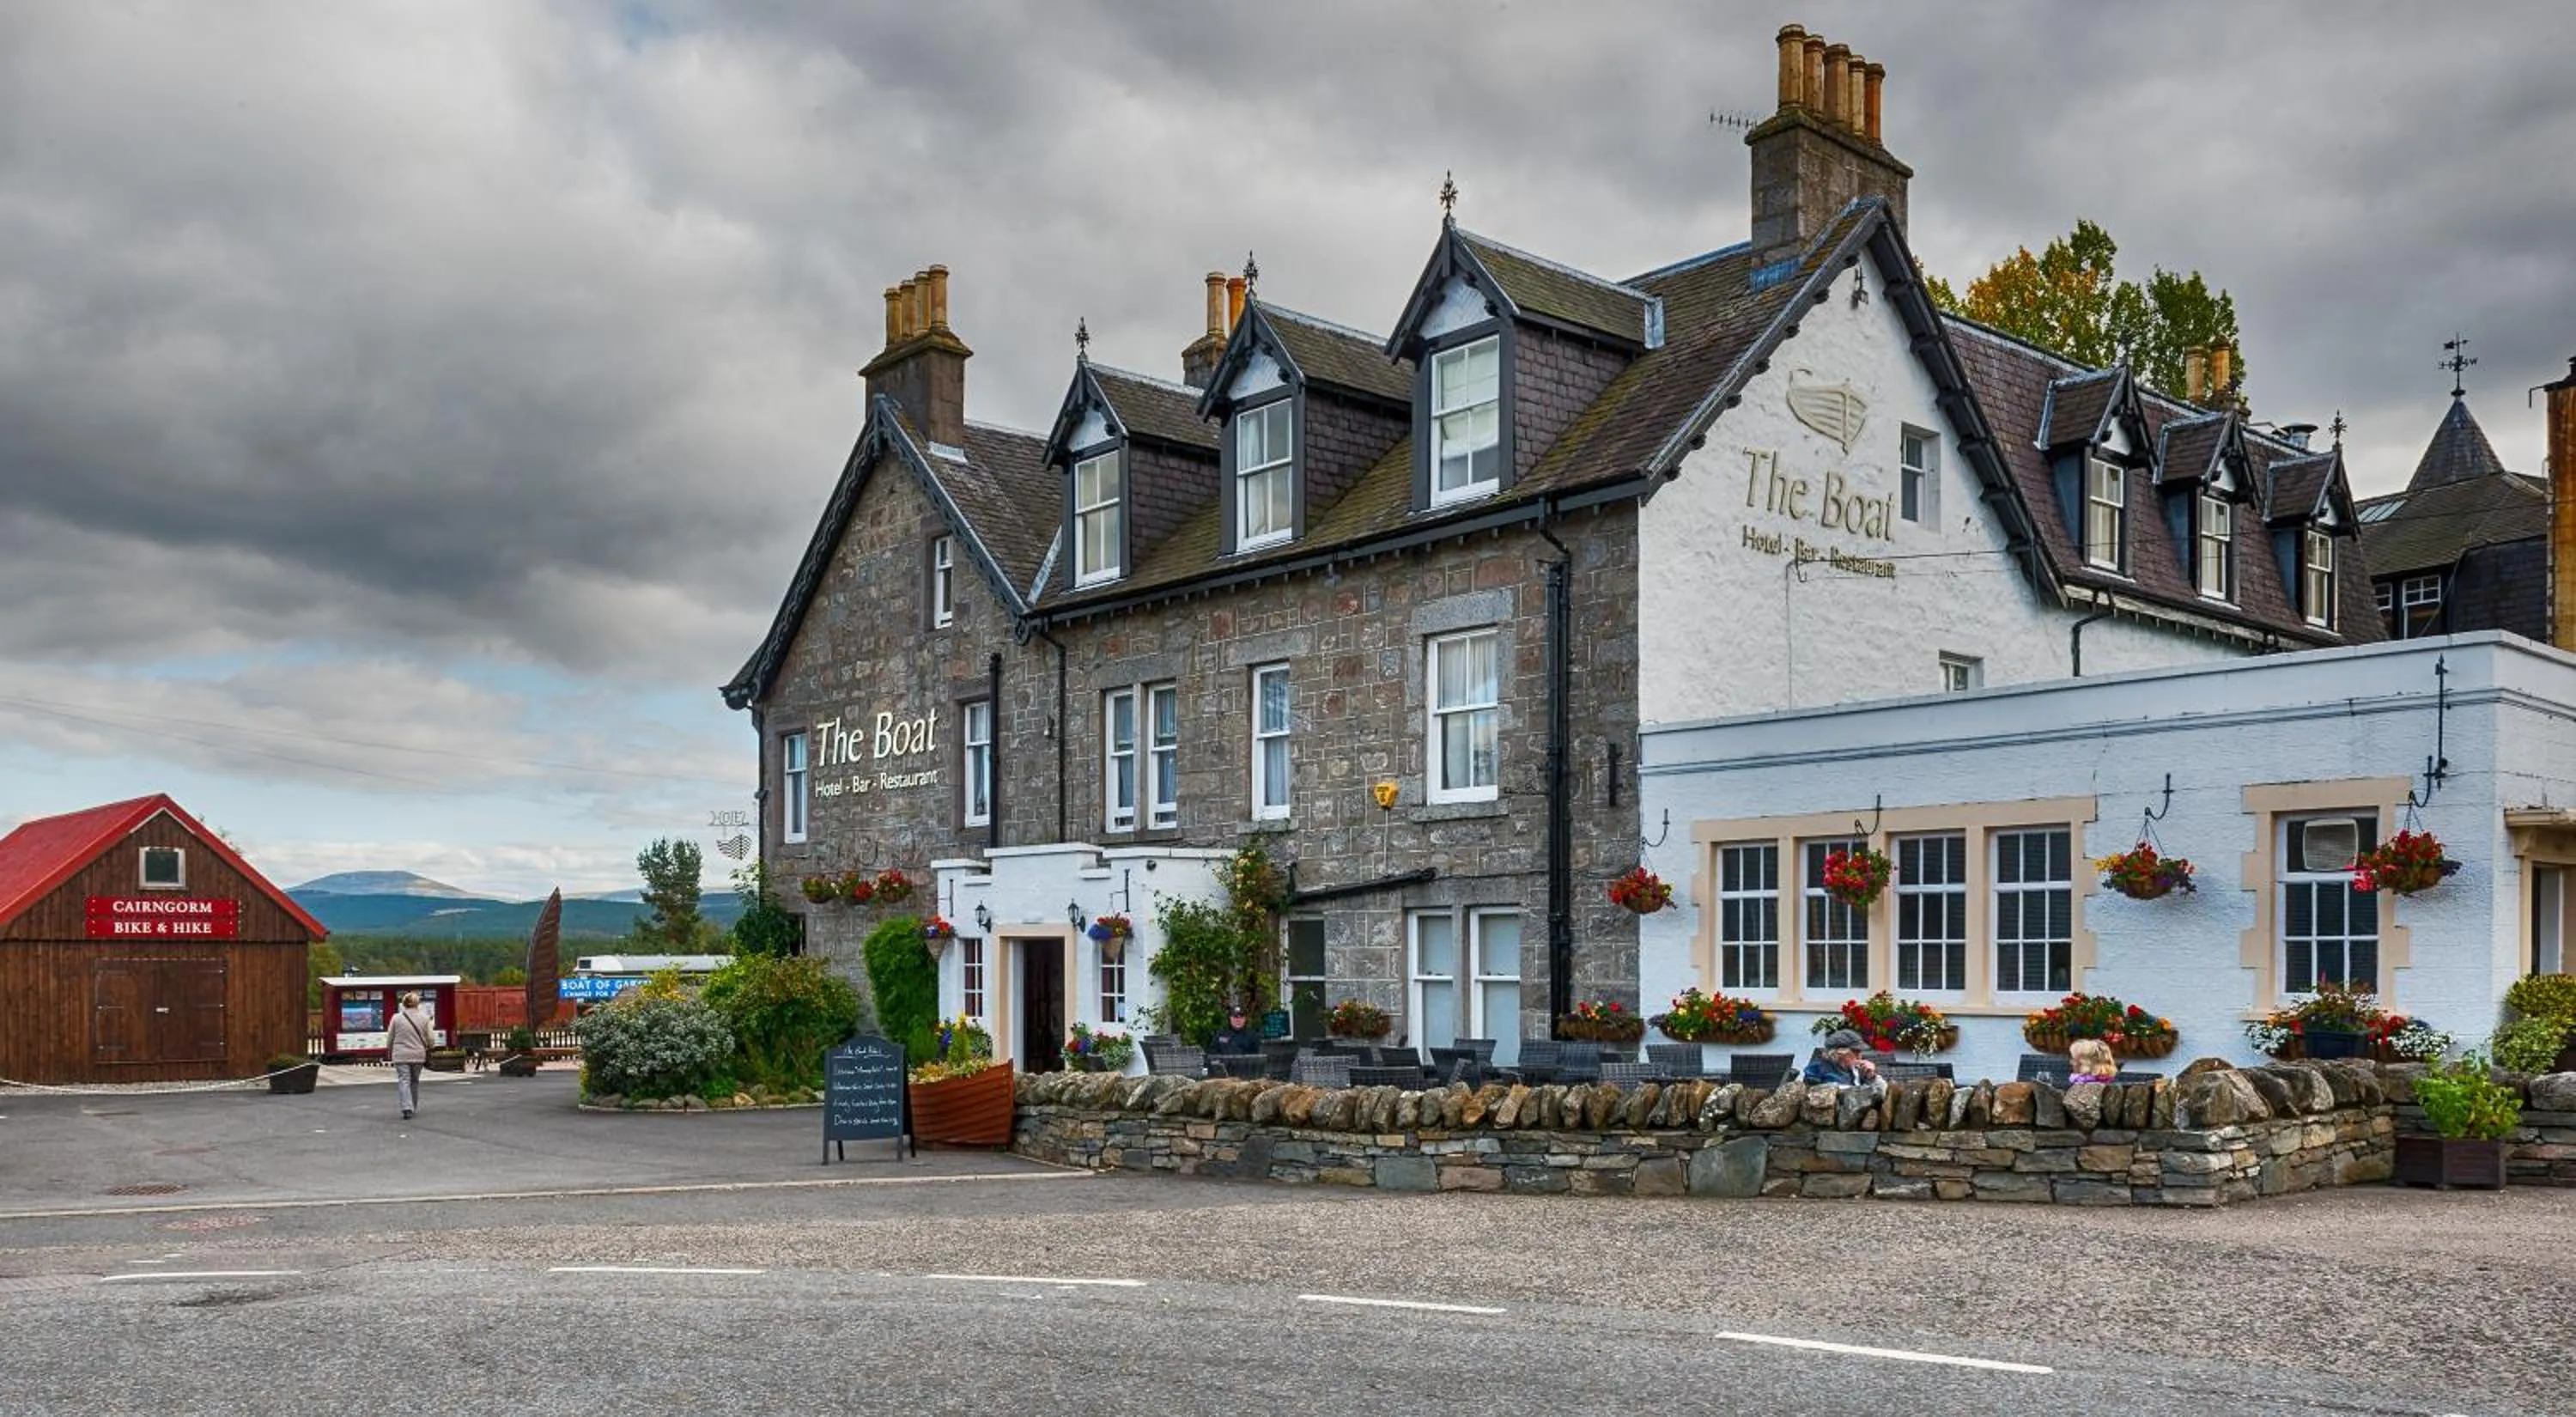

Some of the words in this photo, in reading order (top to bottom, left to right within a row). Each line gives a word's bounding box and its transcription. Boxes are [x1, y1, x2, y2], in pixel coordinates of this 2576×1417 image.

[1742, 447, 1807, 520] The
[1821, 471, 1894, 543] Boat
[1742, 525, 1782, 555] Hotel
[817, 716, 865, 767] The
[873, 707, 938, 759] Boat
[815, 778, 842, 797] Hotel
[853, 775, 871, 794] Bar
[880, 769, 939, 790] Restaurant
[112, 901, 213, 913] CAIRNGORM
[114, 921, 152, 934] BIKE
[157, 922, 167, 933] &
[173, 921, 213, 934] HIKE
[561, 979, 591, 990] BOAT
[596, 979, 610, 990] OF
